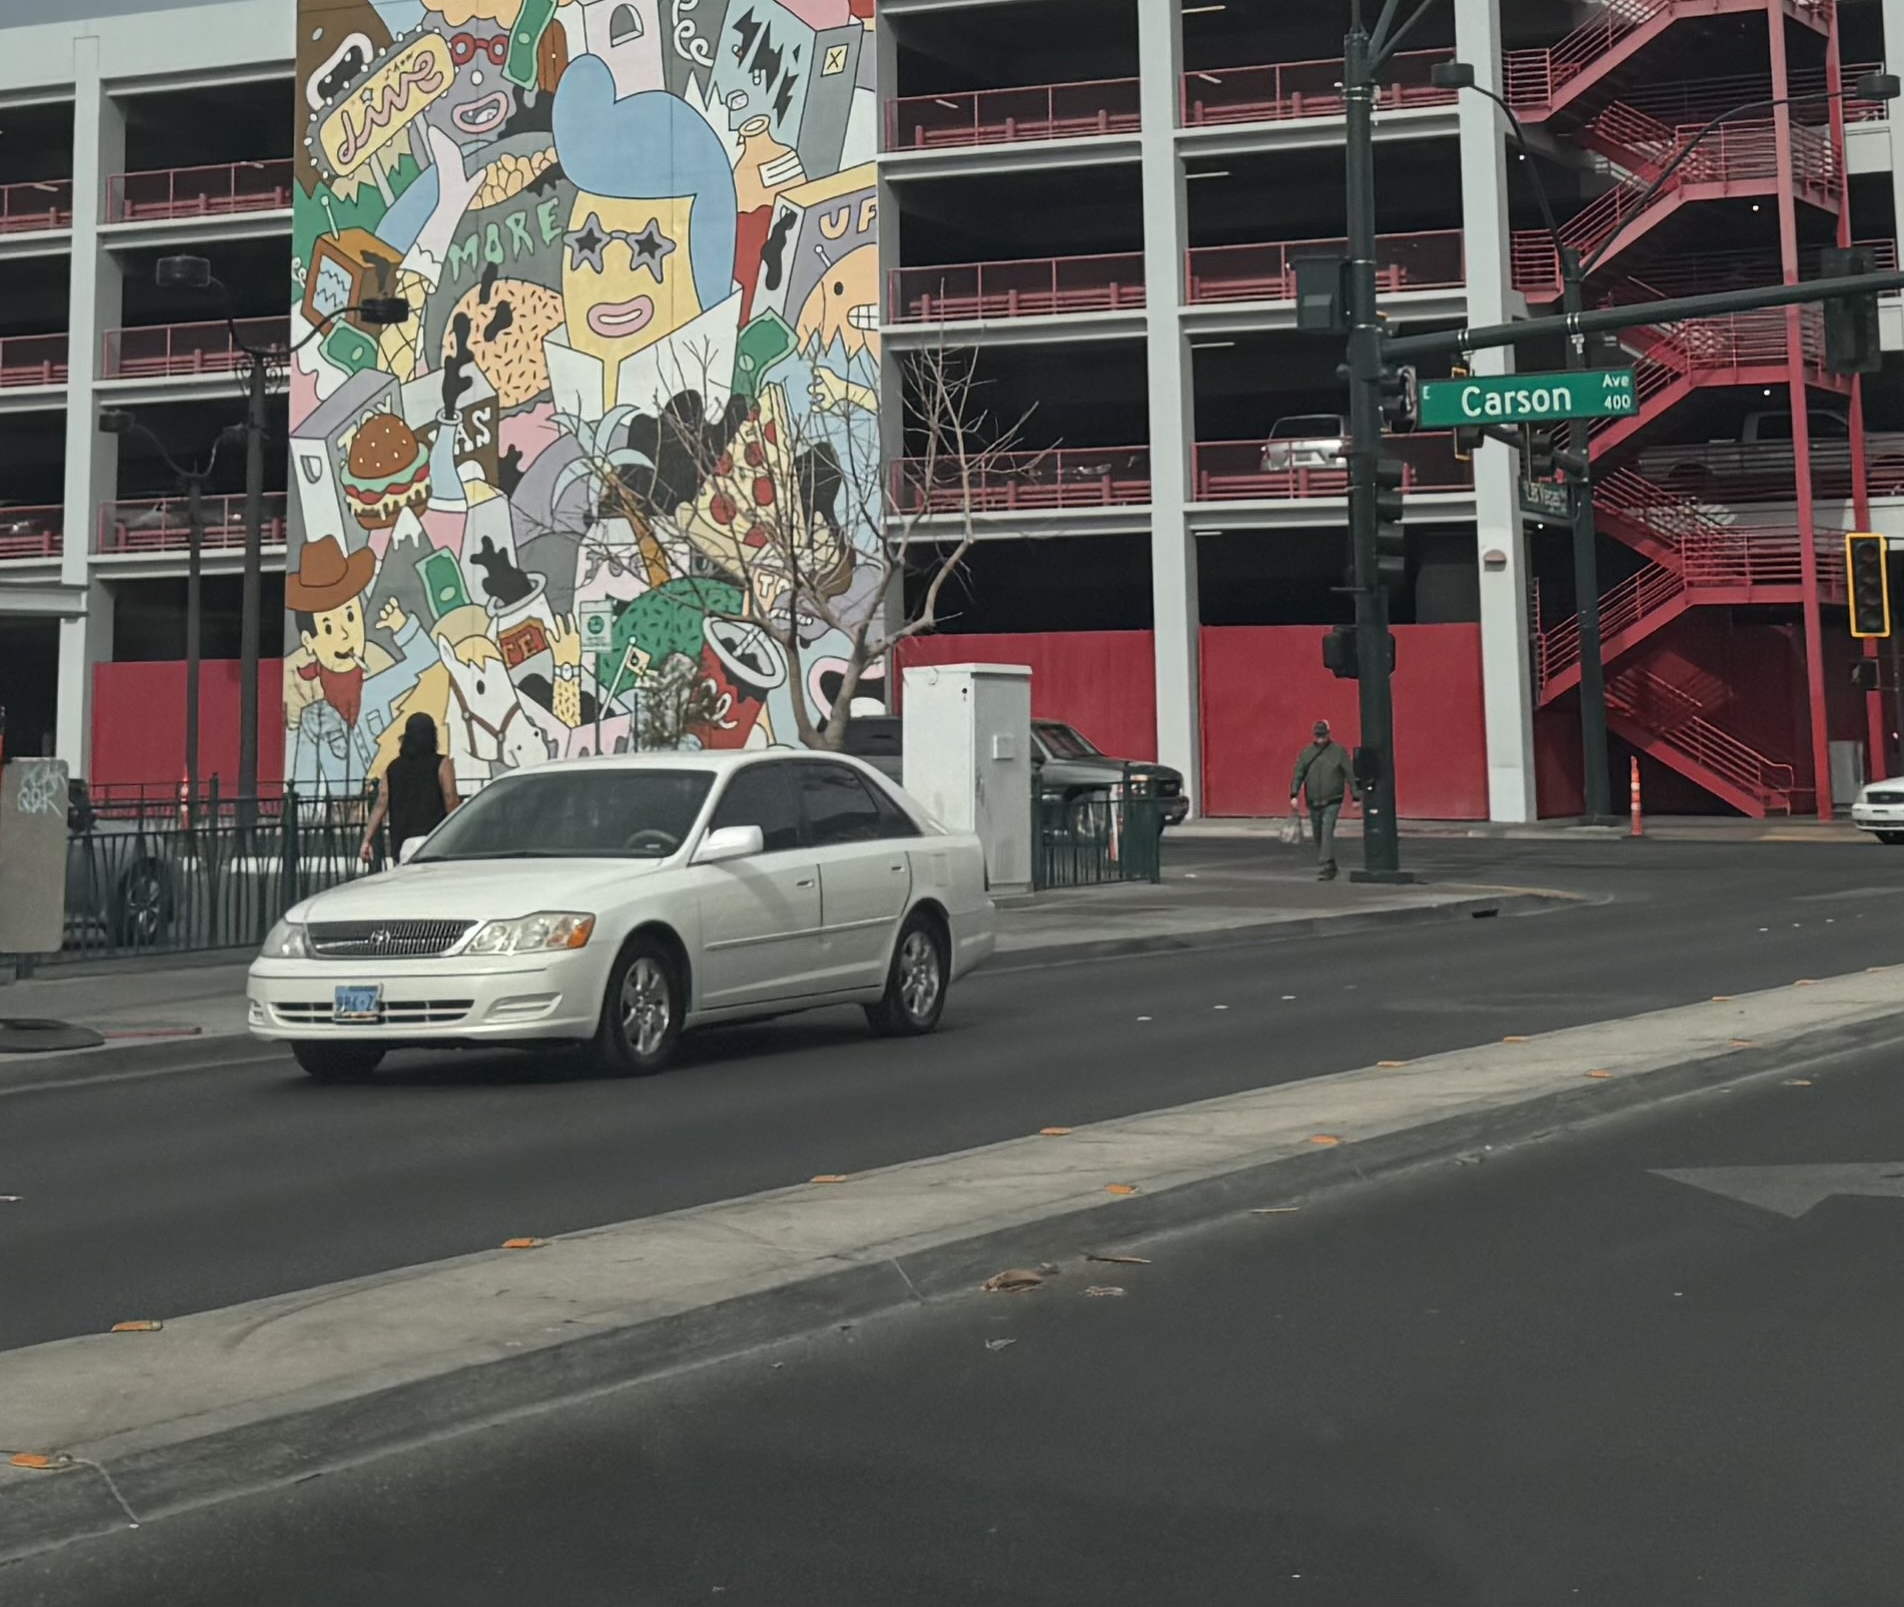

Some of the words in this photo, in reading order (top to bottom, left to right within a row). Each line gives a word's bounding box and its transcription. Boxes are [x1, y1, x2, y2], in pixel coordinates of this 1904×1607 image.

[447, 196, 562, 283] MORE
[1422, 385, 1431, 400] E
[1461, 385, 1572, 417] Carson
[1602, 374, 1629, 388] Ave
[1604, 395, 1631, 410] 400
